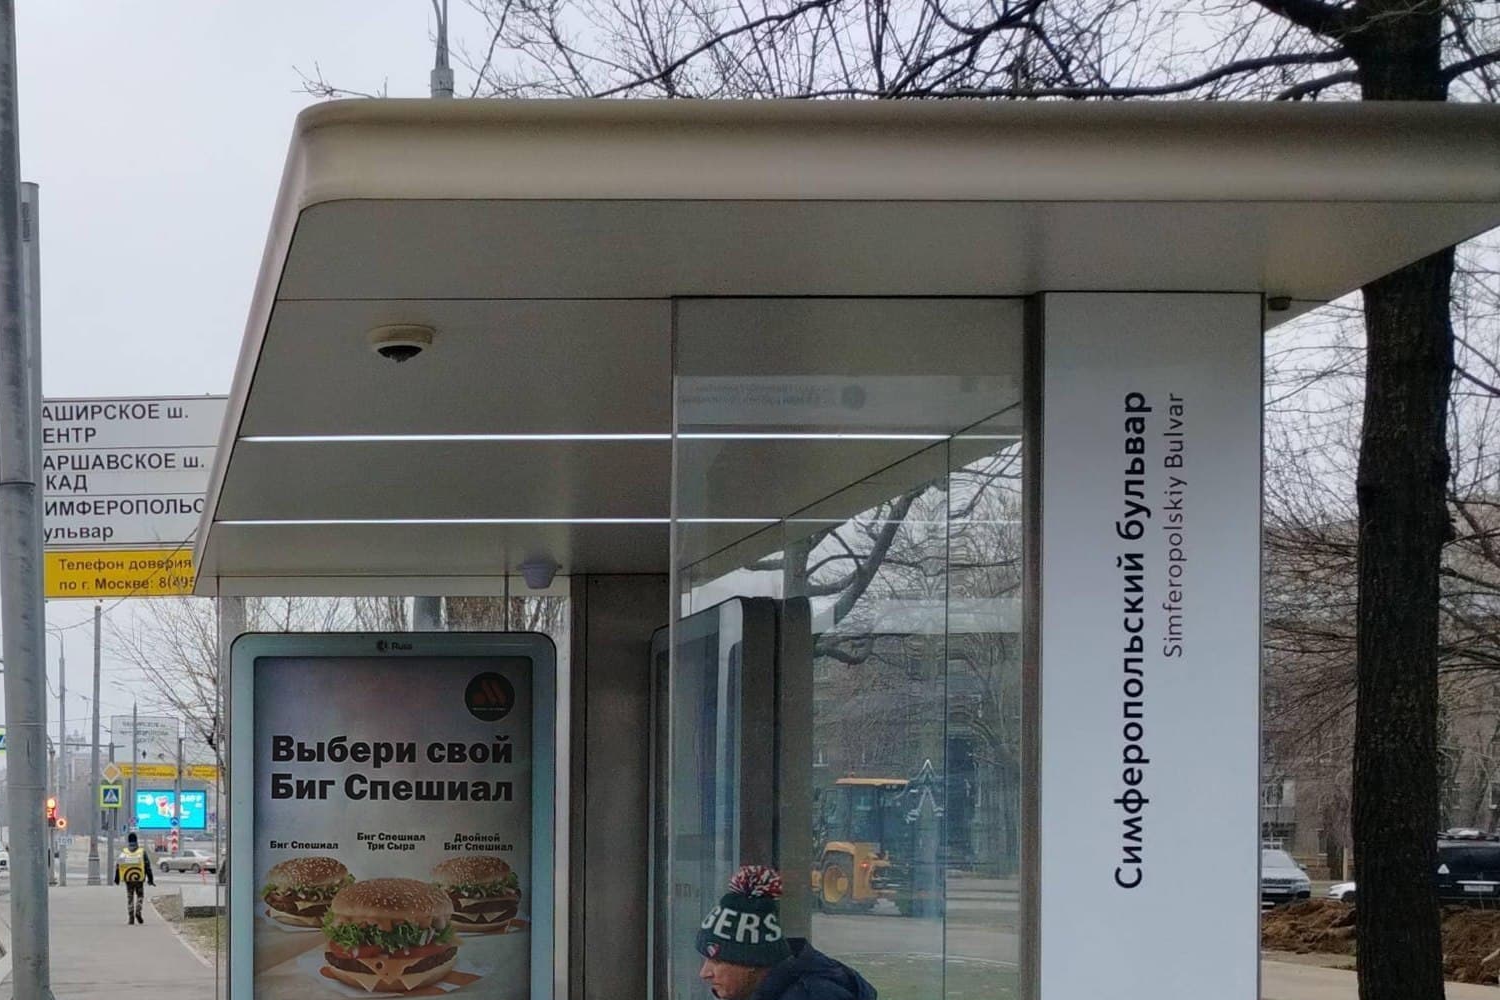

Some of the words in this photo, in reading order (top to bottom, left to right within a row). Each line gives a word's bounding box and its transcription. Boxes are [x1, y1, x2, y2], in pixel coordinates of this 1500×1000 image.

[42, 403, 160, 421] АШИРСКОЕ
[166, 406, 189, 419] ш.
[43, 427, 97, 444] ЕНТР
[1162, 393, 1184, 469] Bulvar
[43, 453, 176, 470] АРШАВСКОЕ
[183, 456, 205, 469] ш.
[1115, 391, 1152, 541] бульвар
[45, 475, 88, 493] КАД
[44, 498, 205, 516] ИМФЕРОПОЛЬС
[43, 526, 114, 543] ульвар
[58, 558, 124, 573] Телефон
[128, 558, 192, 571] доверия
[1162, 476, 1188, 658] Simferopolskiy
[59, 580, 77, 590] по
[81, 580, 90, 590] г.
[1113, 554, 1151, 889] Симферопольский
[272, 735, 417, 768] Выбери
[426, 734, 513, 764] свой
[271, 773, 336, 800] Биг
[344, 772, 514, 802] Спешиал
[269, 840, 289, 849] Биг
[291, 840, 339, 850] Спешиал
[356, 832, 377, 841] Биг
[378, 832, 426, 842] Спешиал
[453, 832, 501, 844] Двойной
[367, 841, 387, 853] Три
[389, 842, 416, 853] Сыра
[443, 842, 463, 852] Биг
[465, 842, 514, 853] Спешиал
